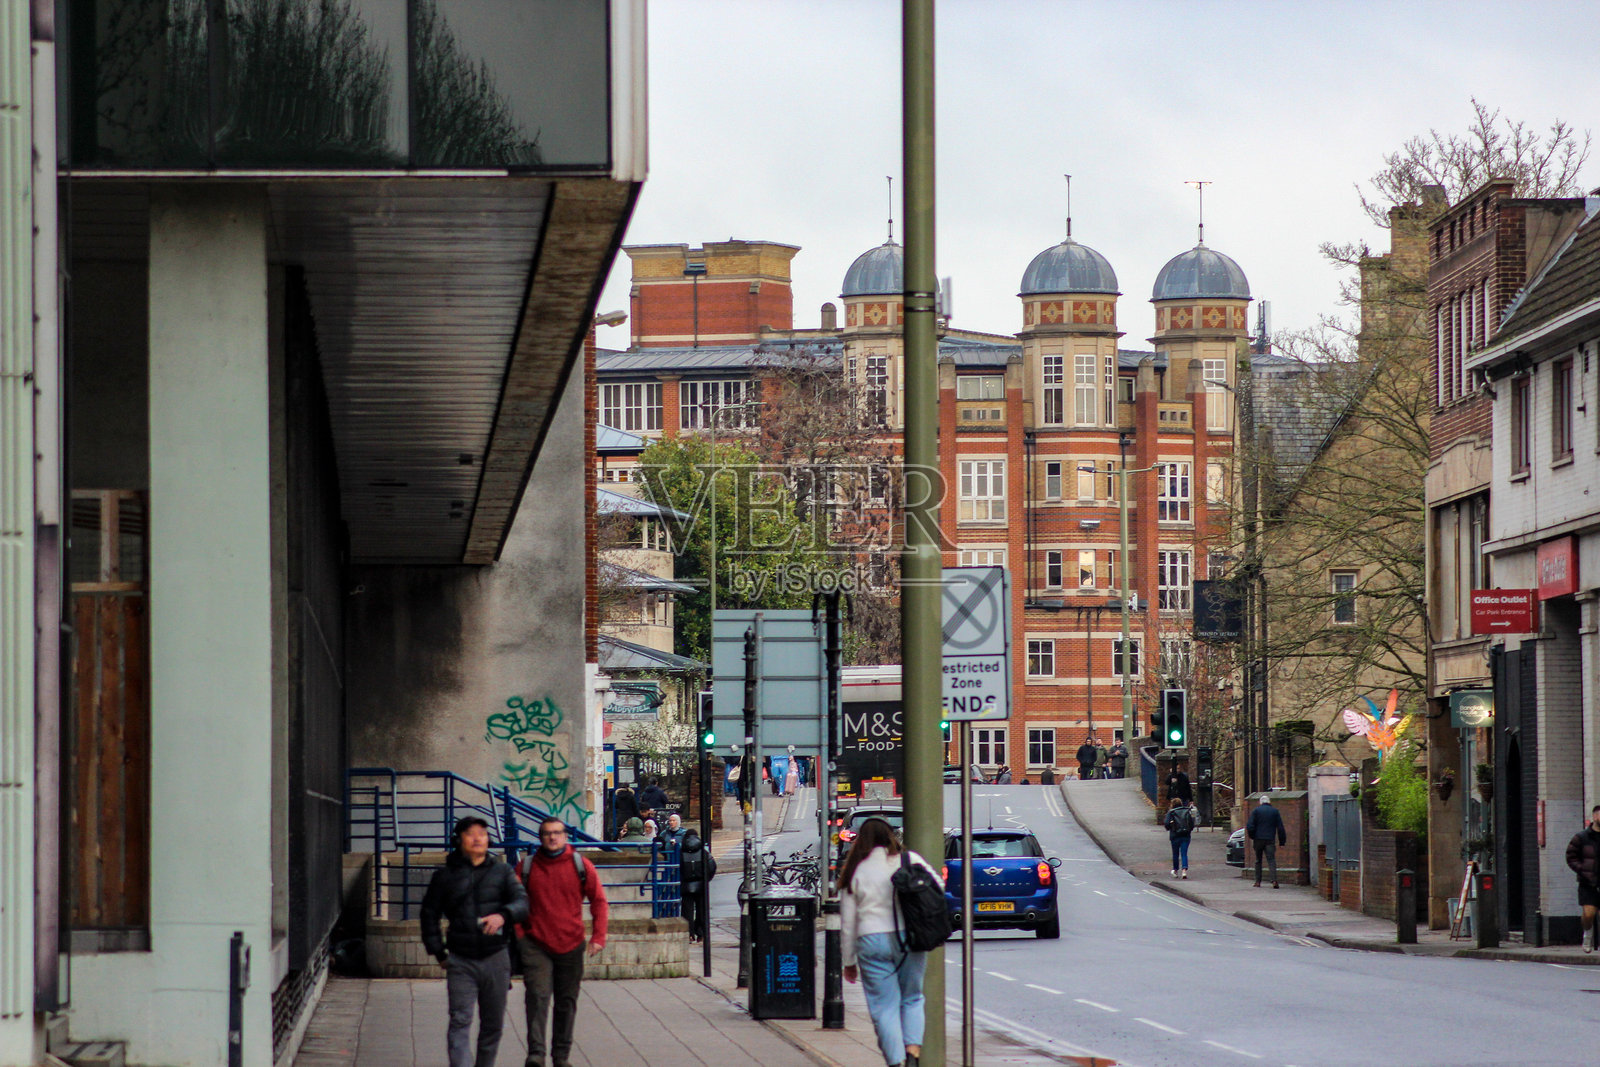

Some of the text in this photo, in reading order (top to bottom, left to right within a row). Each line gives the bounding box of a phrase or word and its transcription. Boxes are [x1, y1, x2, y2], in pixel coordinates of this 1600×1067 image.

[1474, 595, 1528, 604] Office Outlet
[942, 660, 1000, 673] estricted
[951, 677, 983, 689] Zone
[844, 711, 903, 738] M&S
[858, 741, 895, 752] FOOD
